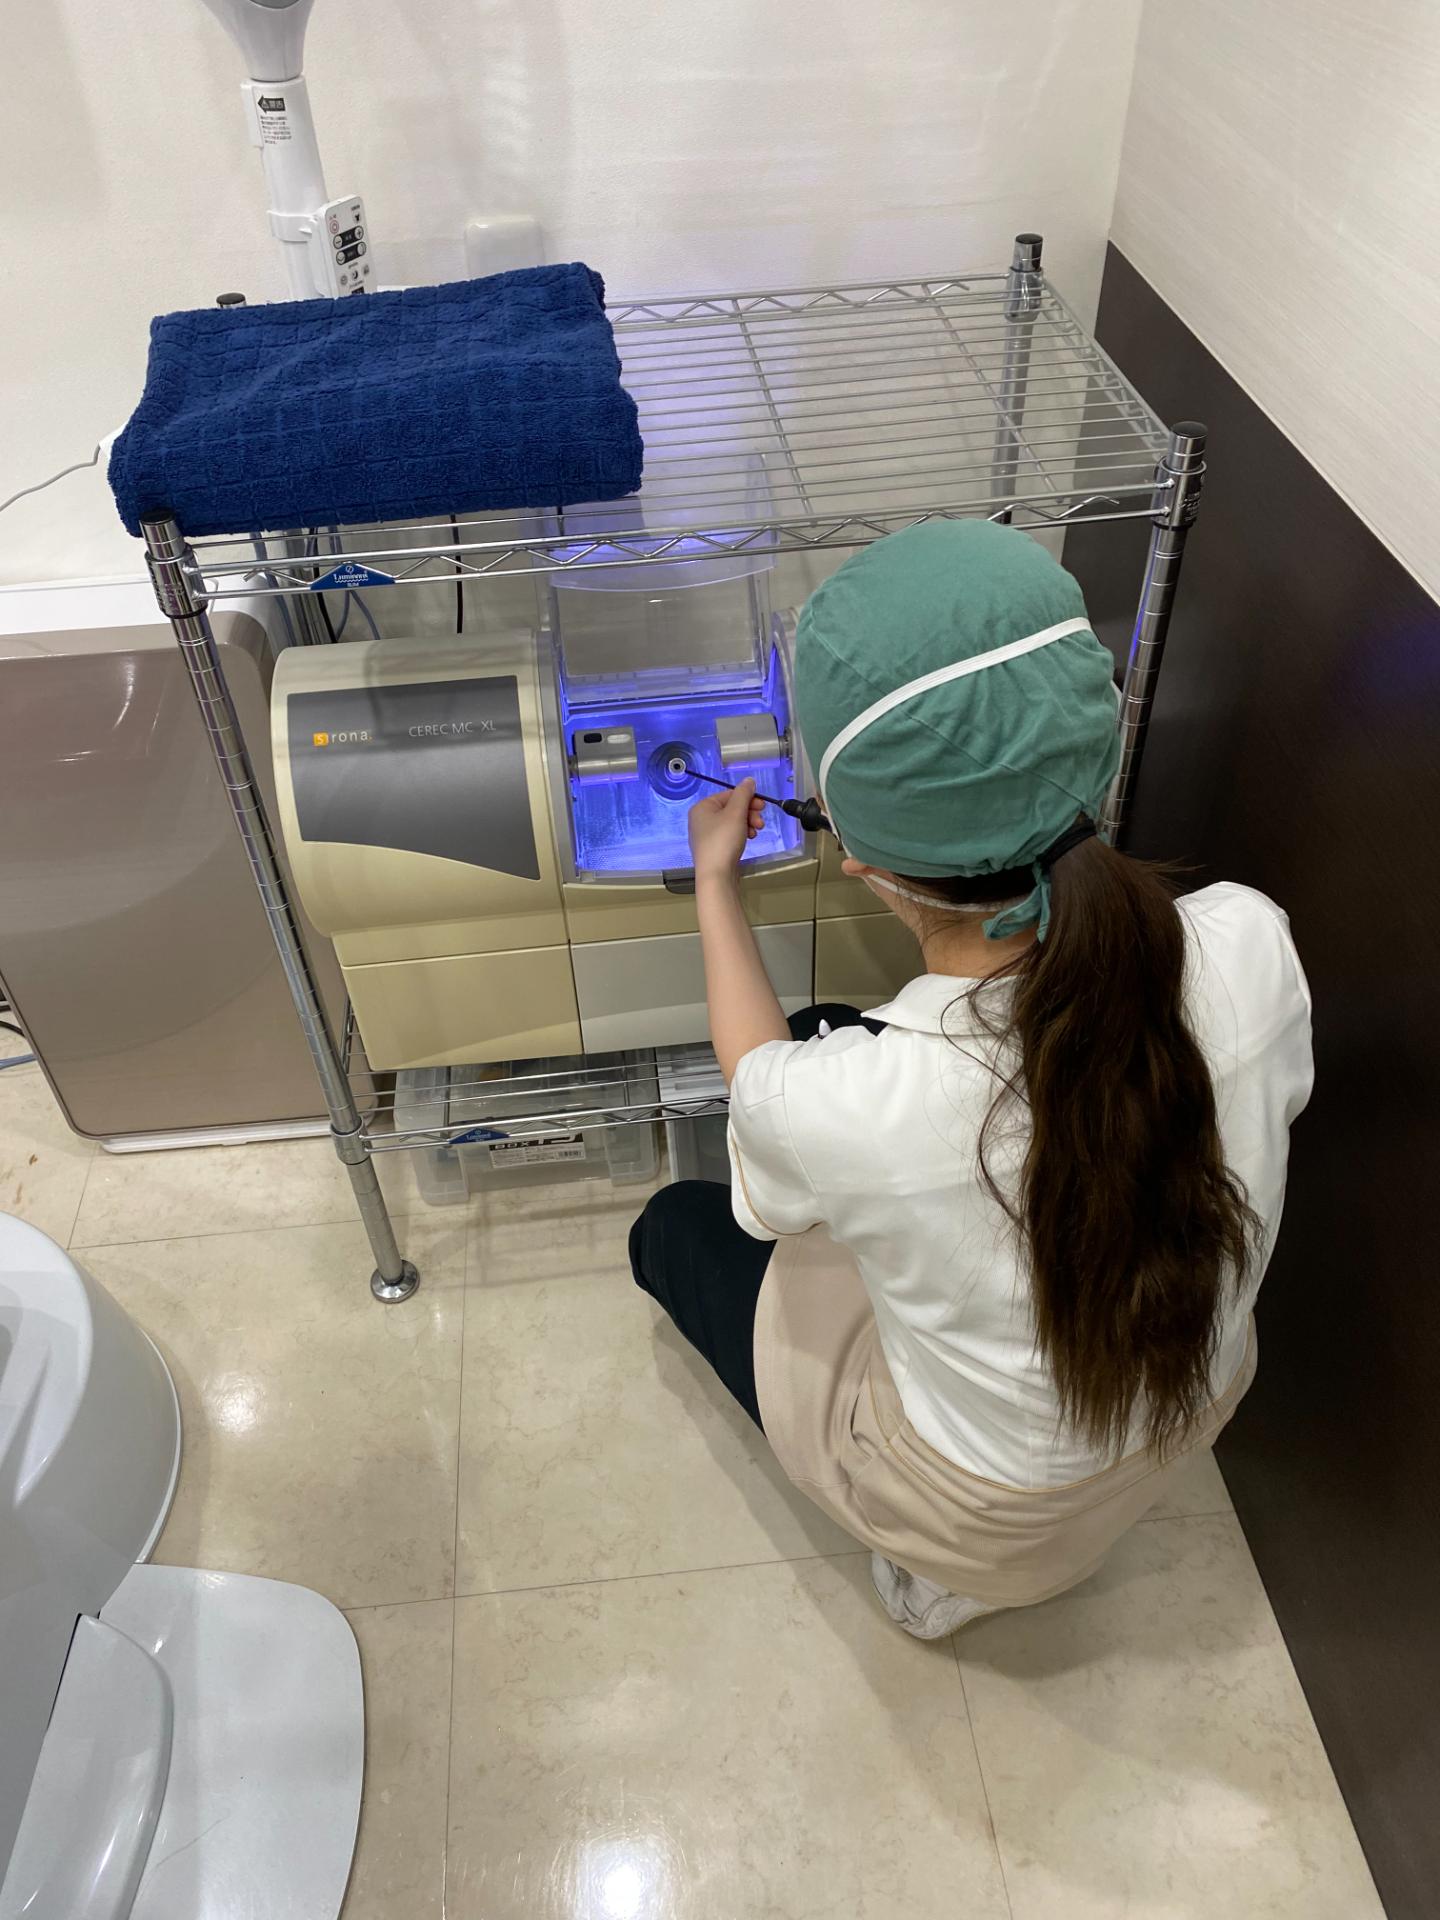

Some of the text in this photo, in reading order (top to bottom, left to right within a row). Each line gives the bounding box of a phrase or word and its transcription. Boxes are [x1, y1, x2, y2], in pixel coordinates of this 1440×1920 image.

[408, 719, 497, 737] CEREC MC XL
